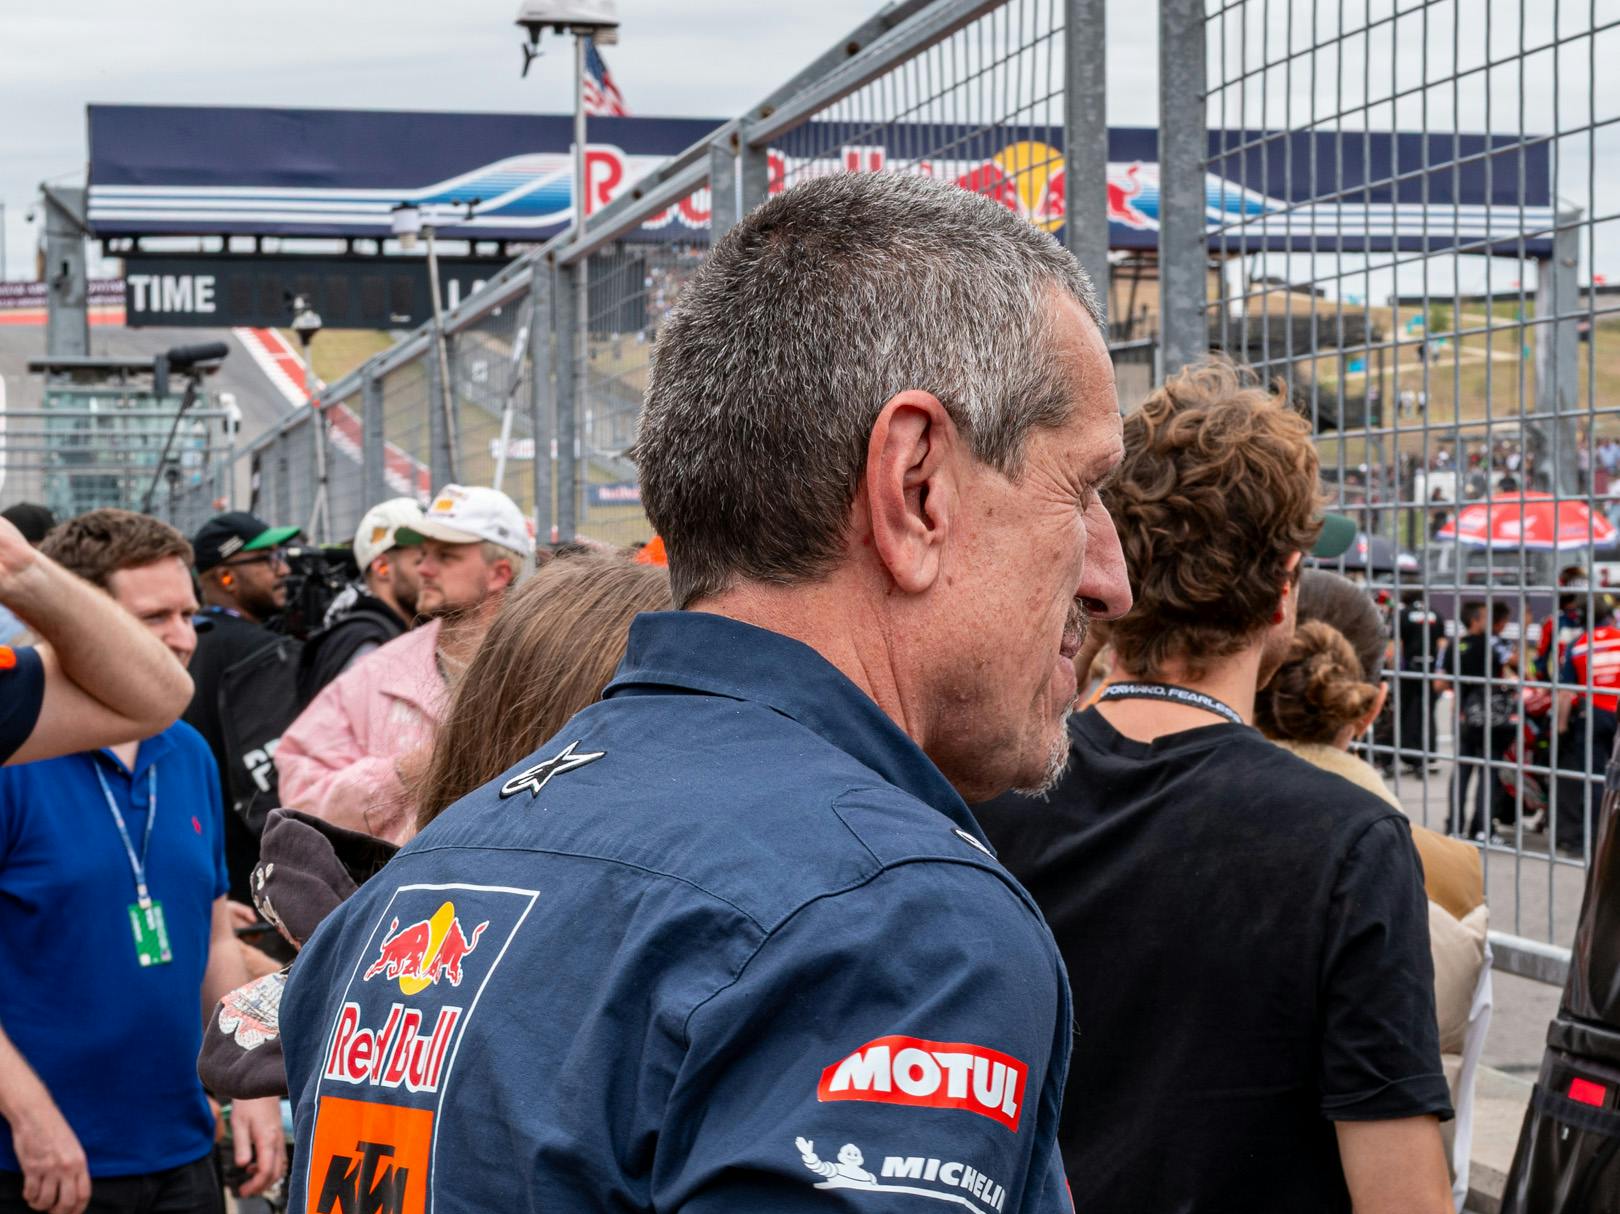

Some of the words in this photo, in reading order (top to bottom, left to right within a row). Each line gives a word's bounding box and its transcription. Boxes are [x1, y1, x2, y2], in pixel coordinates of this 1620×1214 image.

[127, 274, 216, 313] TIME
[324, 1001, 404, 1086] Red
[381, 1004, 463, 1093] Bull
[829, 1046, 1018, 1118] MOTUL
